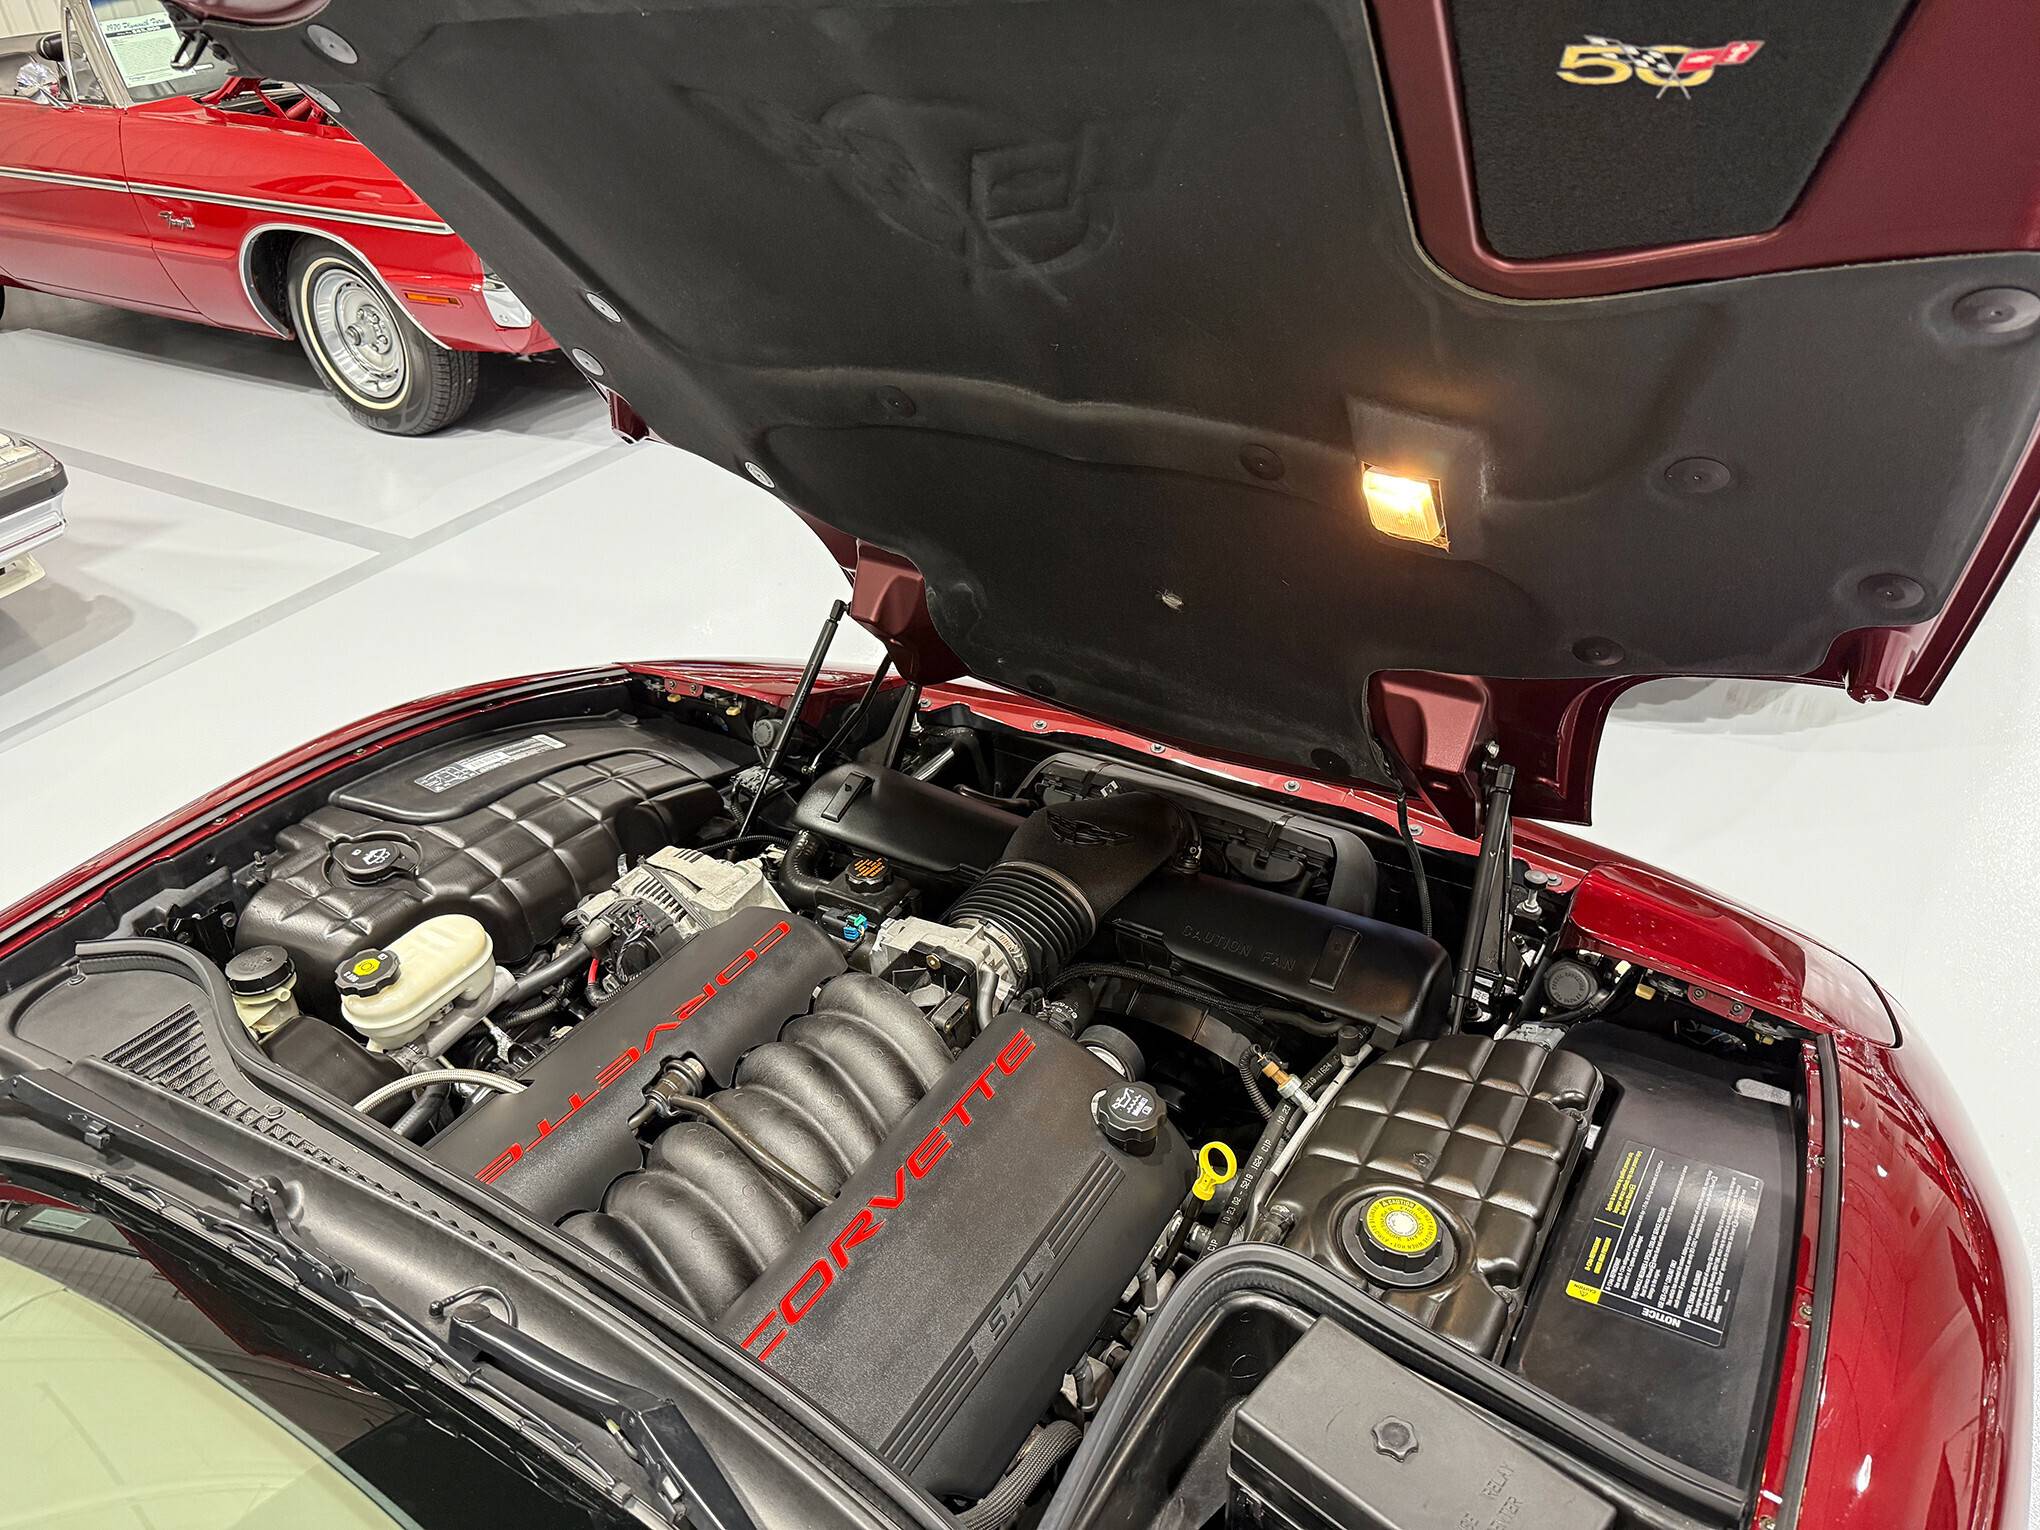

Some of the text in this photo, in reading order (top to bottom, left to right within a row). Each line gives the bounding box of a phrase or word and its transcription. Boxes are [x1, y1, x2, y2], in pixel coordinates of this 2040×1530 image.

[1182, 925, 1297, 972] CAUTION FAN
[474, 920, 792, 1185] CORVETTE
[988, 1271, 1044, 1341] 5.7L
[1642, 1308, 1682, 1328] NOTICE
[1480, 1463, 1514, 1500] RELAY
